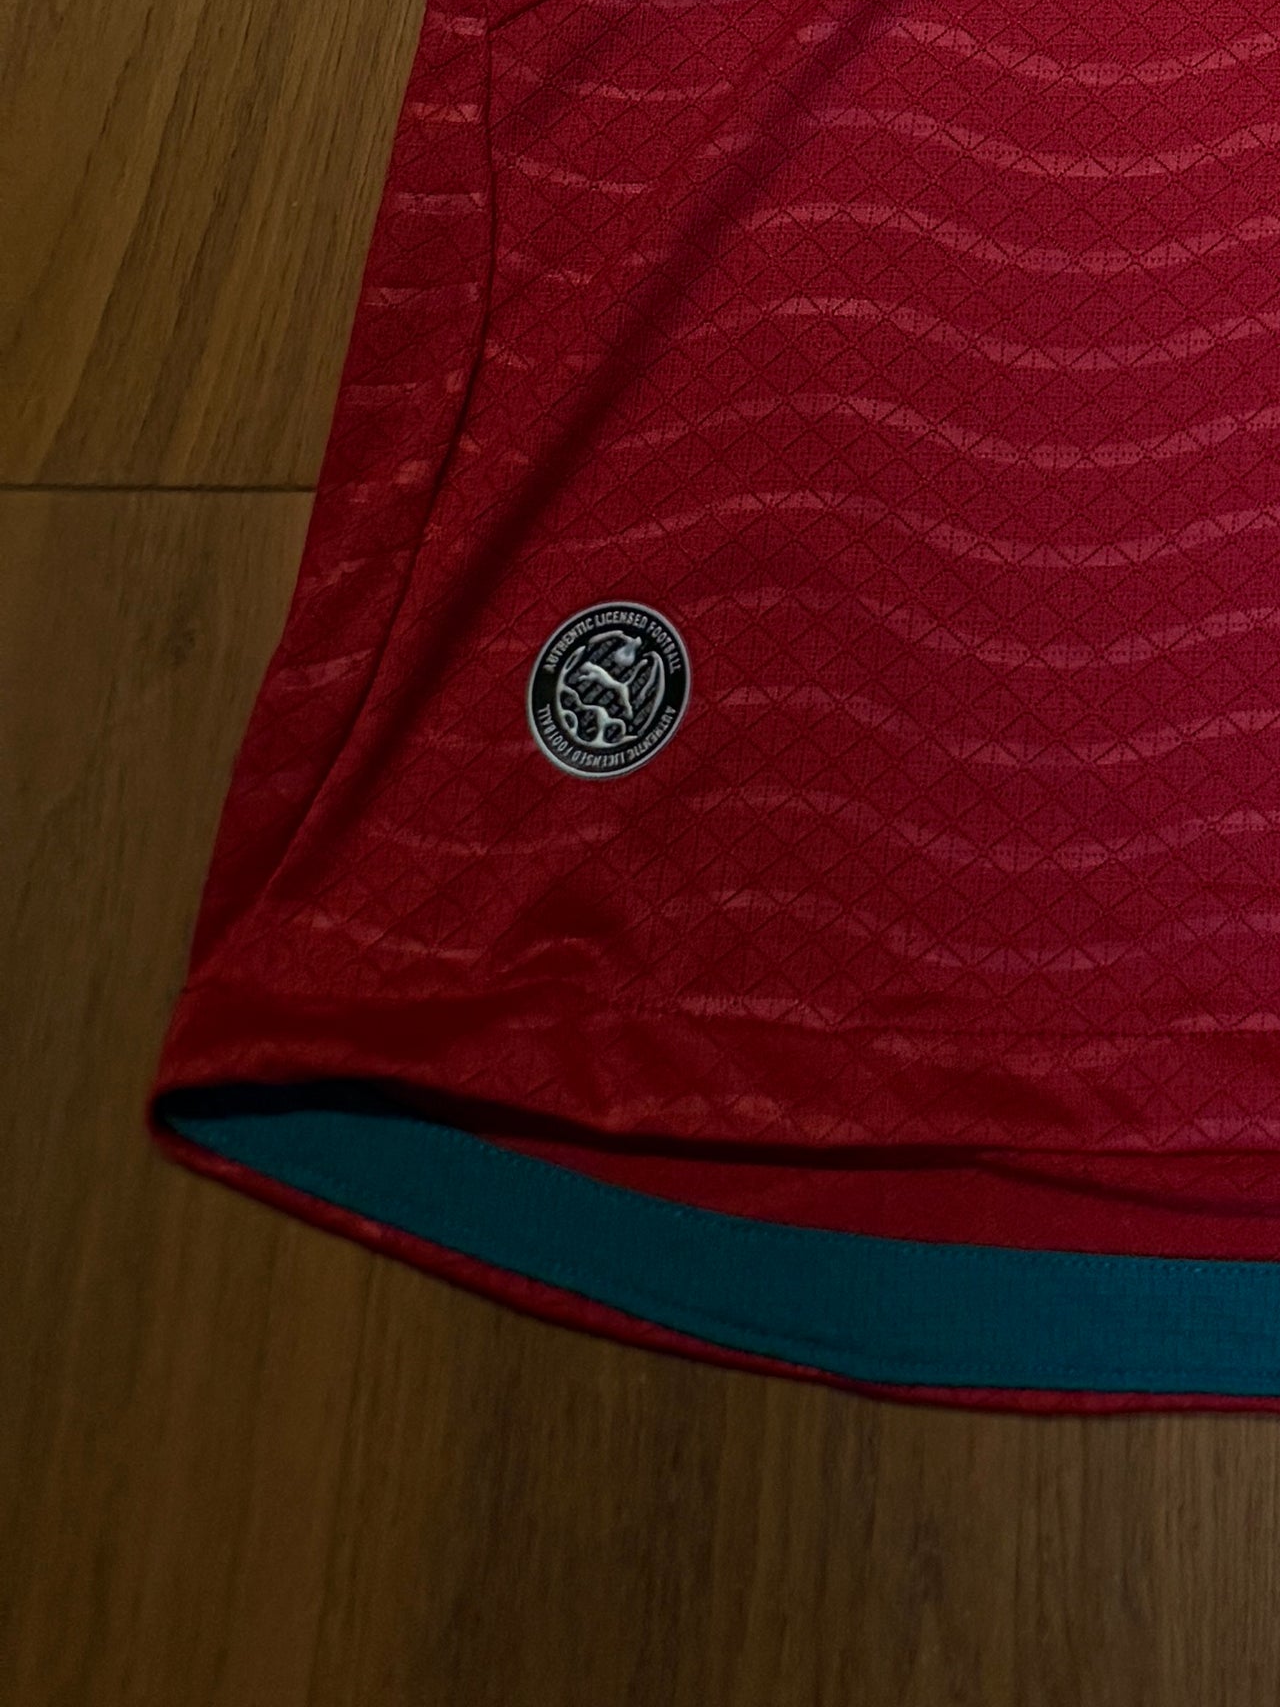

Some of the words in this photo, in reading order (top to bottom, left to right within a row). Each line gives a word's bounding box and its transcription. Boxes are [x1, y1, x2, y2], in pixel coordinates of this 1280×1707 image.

[542, 617, 595, 674] AUTHENTIC
[594, 610, 649, 629] LICENSED
[646, 621, 682, 675] FOOTBALL
[537, 703, 574, 758] FOOTBALL
[626, 705, 677, 760] AUTHENTIC
[571, 750, 626, 769] LICENSED
